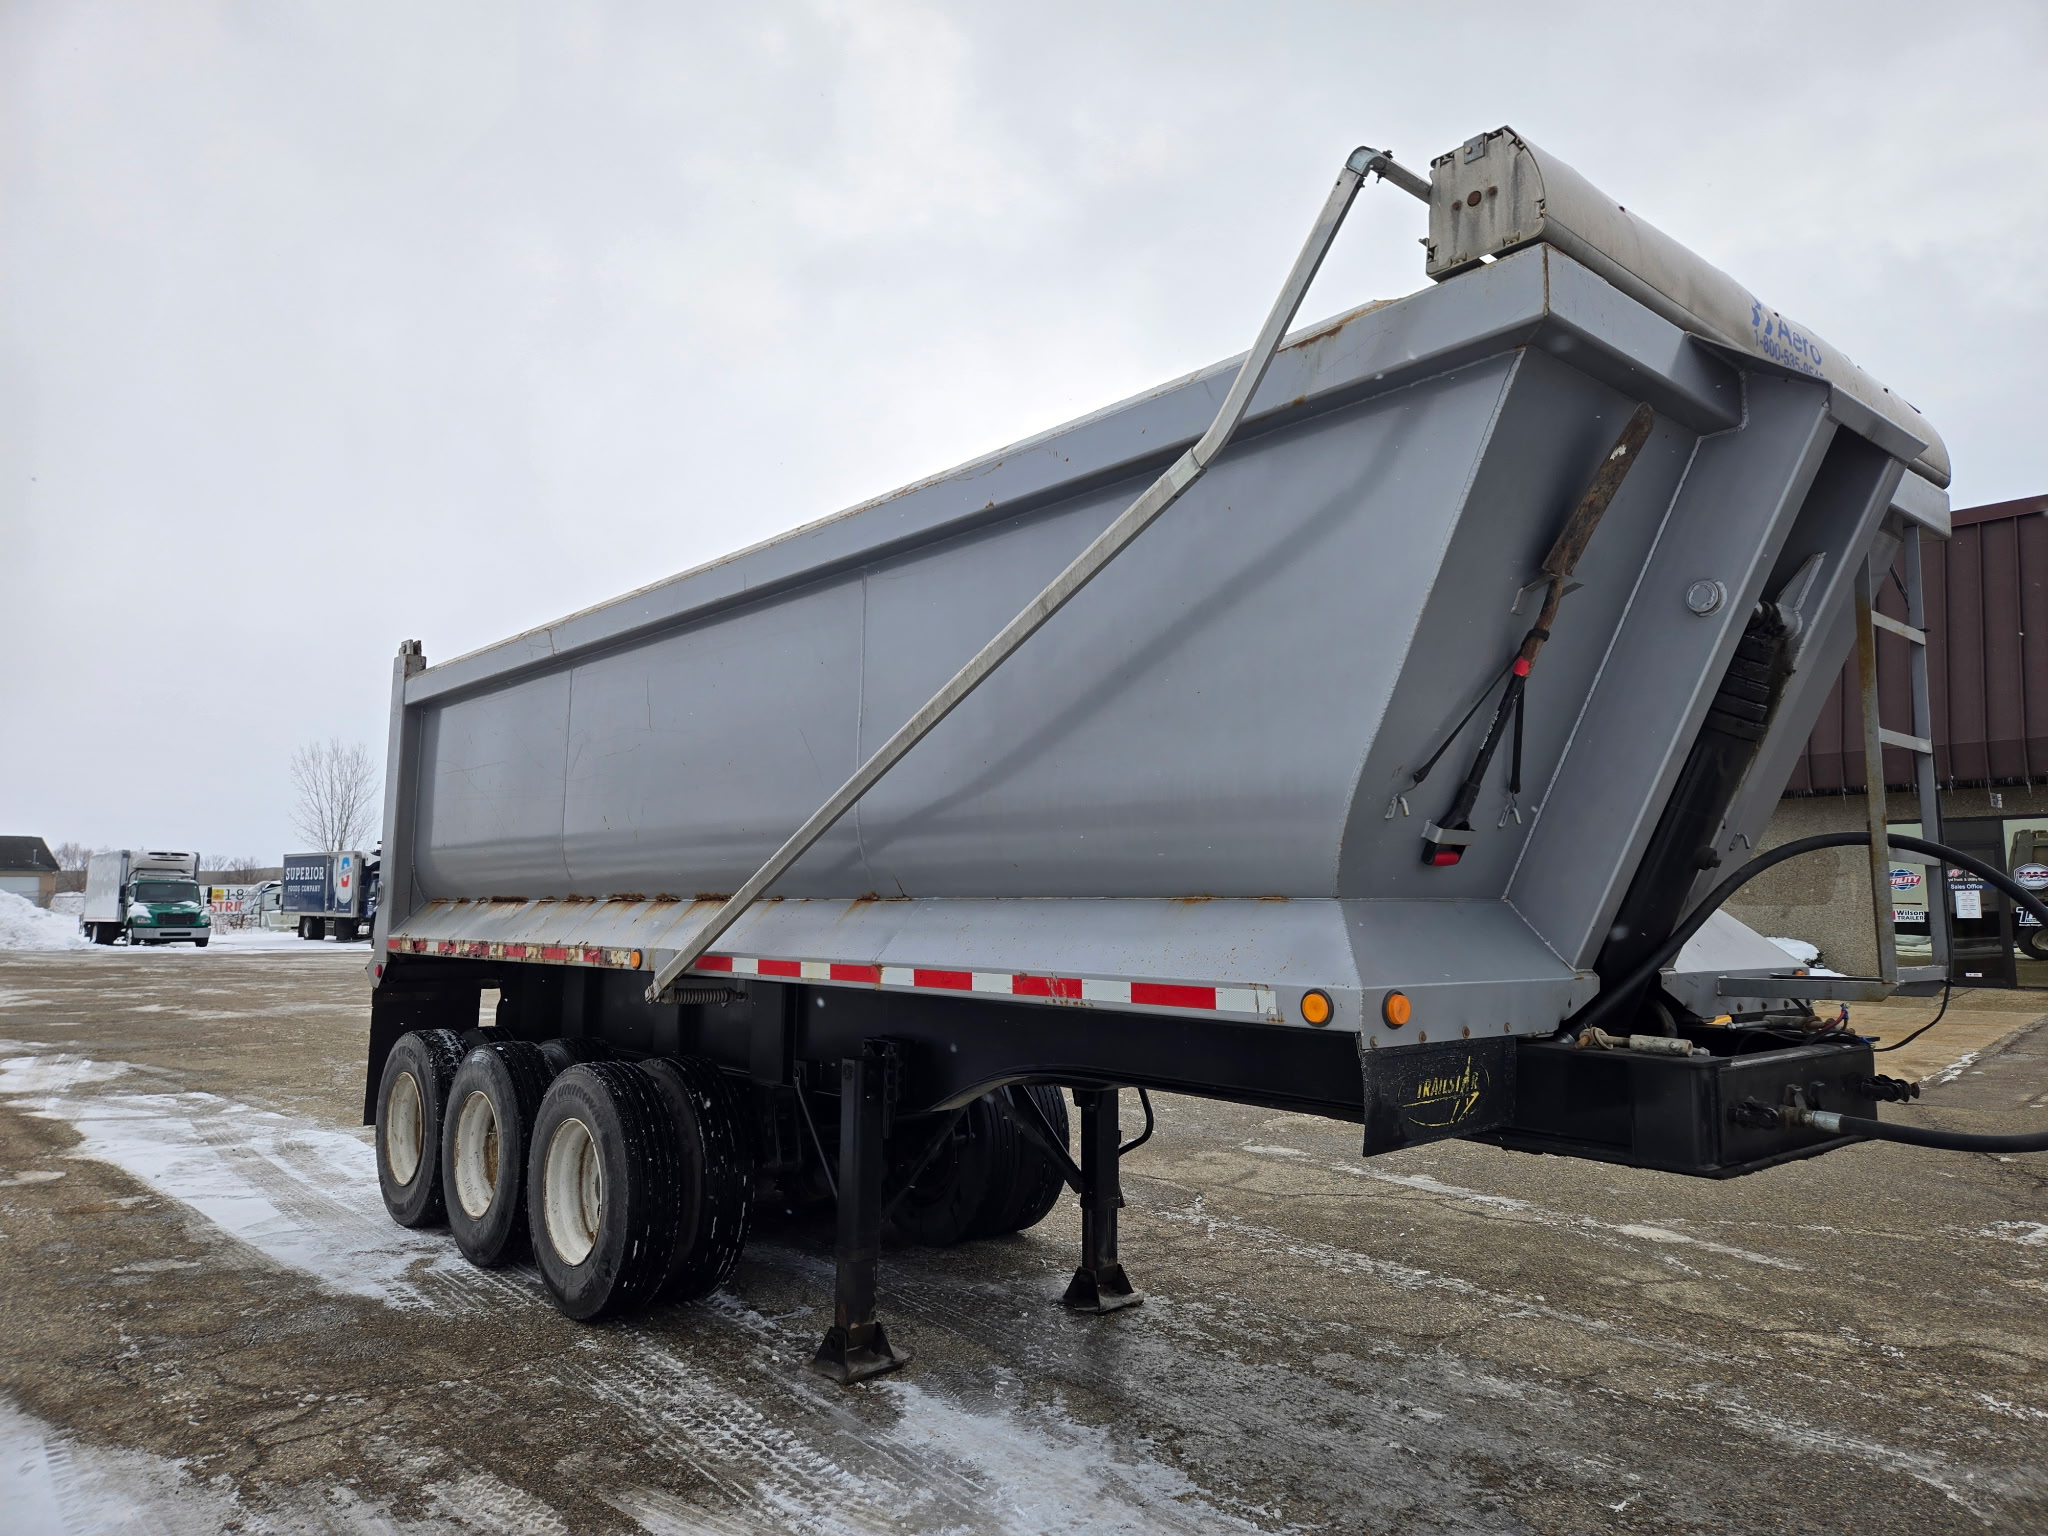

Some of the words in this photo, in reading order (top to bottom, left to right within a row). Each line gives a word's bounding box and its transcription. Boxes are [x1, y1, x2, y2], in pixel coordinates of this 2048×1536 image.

[1778, 318, 1822, 366] Aero
[285, 866, 325, 881] SUPERIOR
[1890, 875, 1920, 885] TILITY
[225, 888, 245, 901] 1-8
[301, 884, 321, 893] COMPANY
